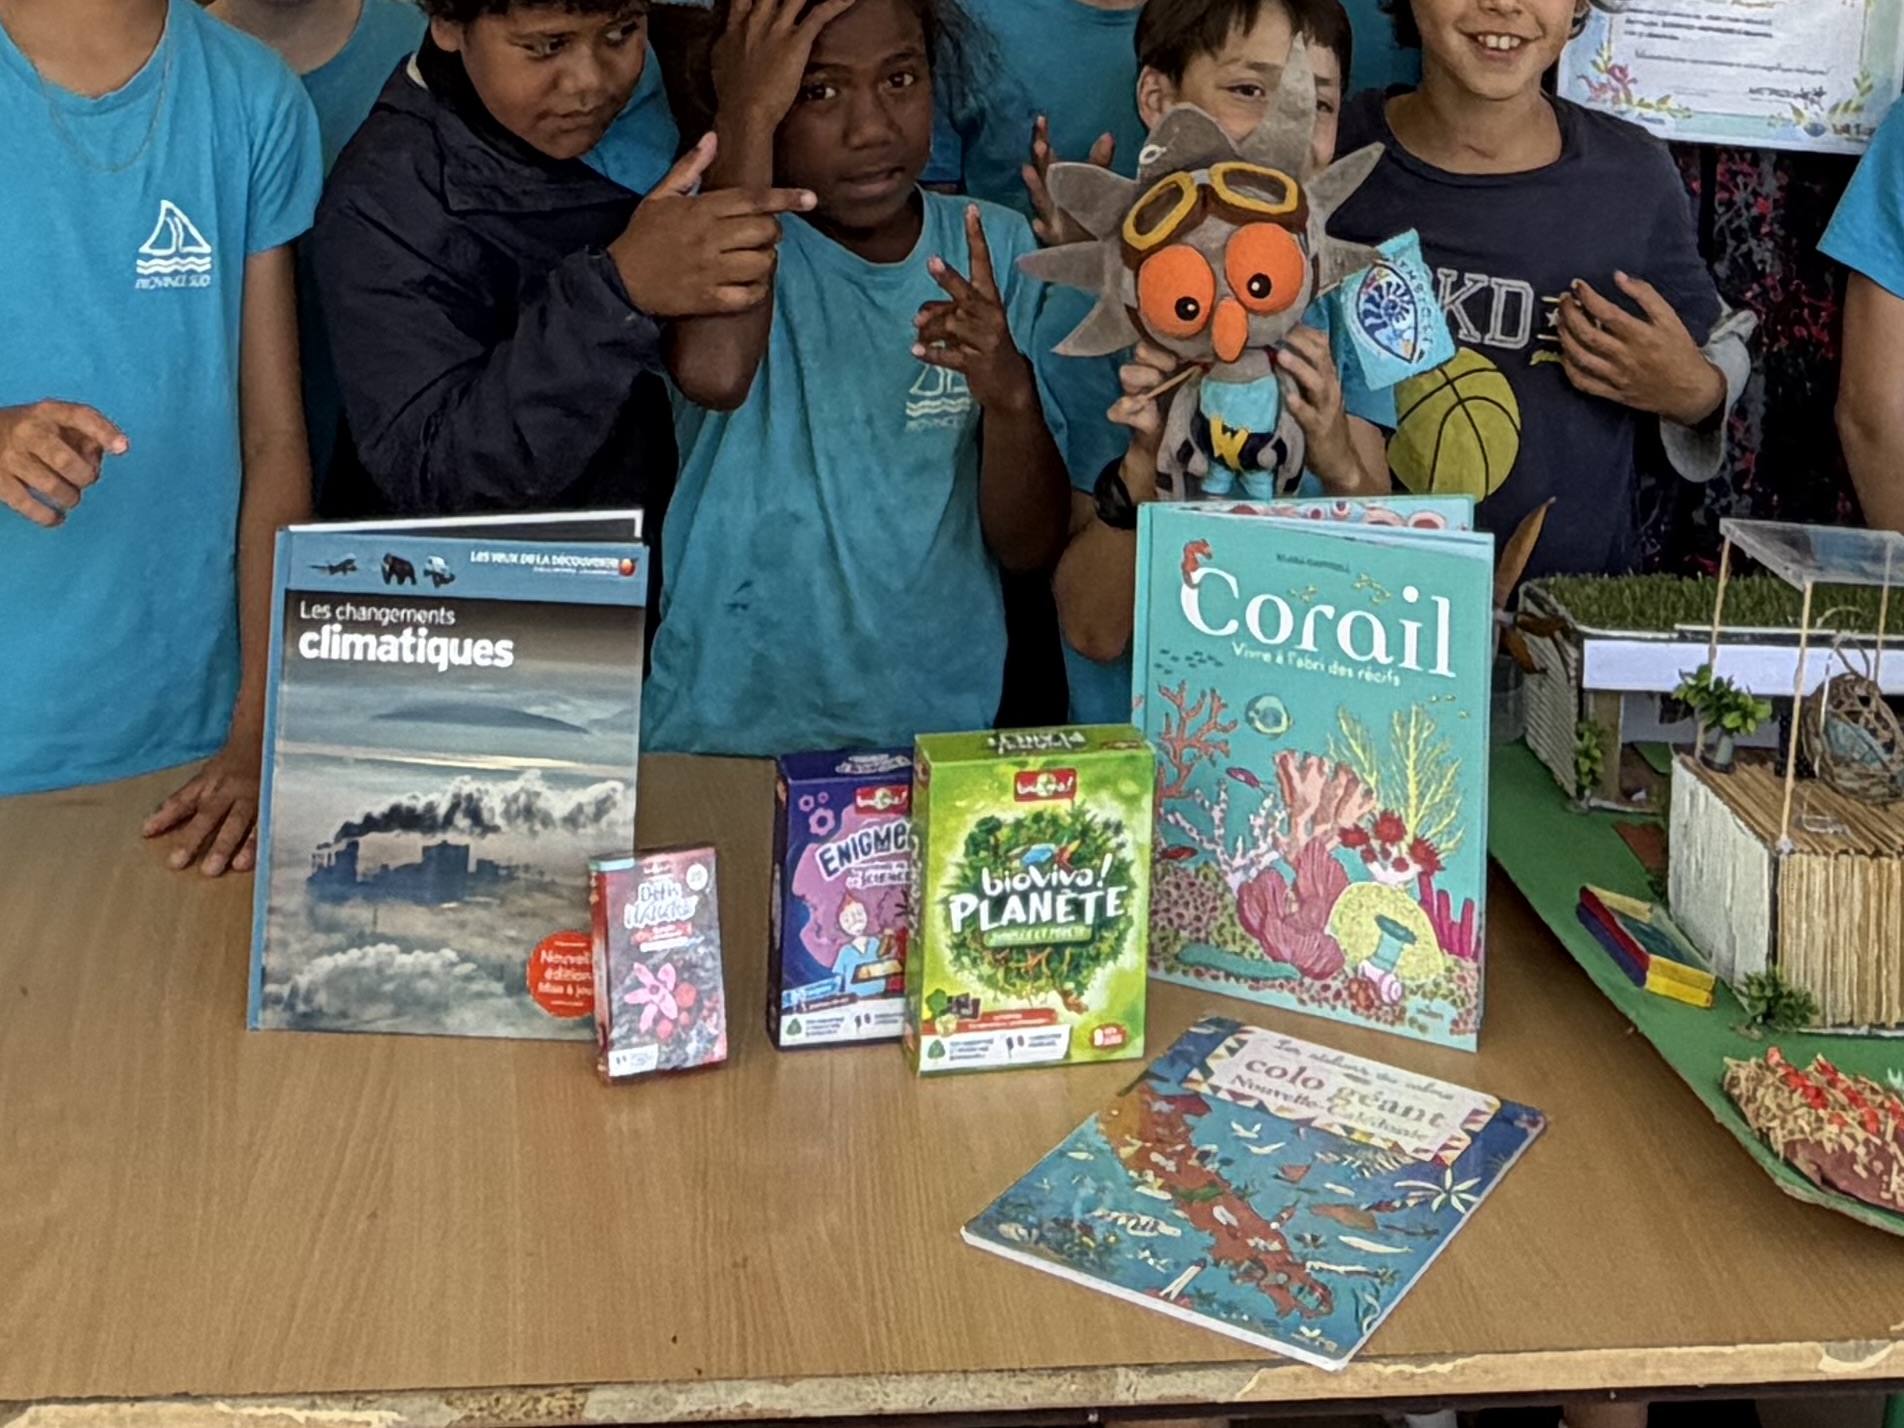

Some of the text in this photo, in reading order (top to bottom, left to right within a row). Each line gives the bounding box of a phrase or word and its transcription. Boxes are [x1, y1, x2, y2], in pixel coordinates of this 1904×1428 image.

[299, 600, 456, 626] Les changements
[1180, 567, 1456, 678] Corail
[298, 623, 515, 673] climatiques
[1327, 659, 1354, 679] des
[1244, 1058, 1447, 1129] colo géant
